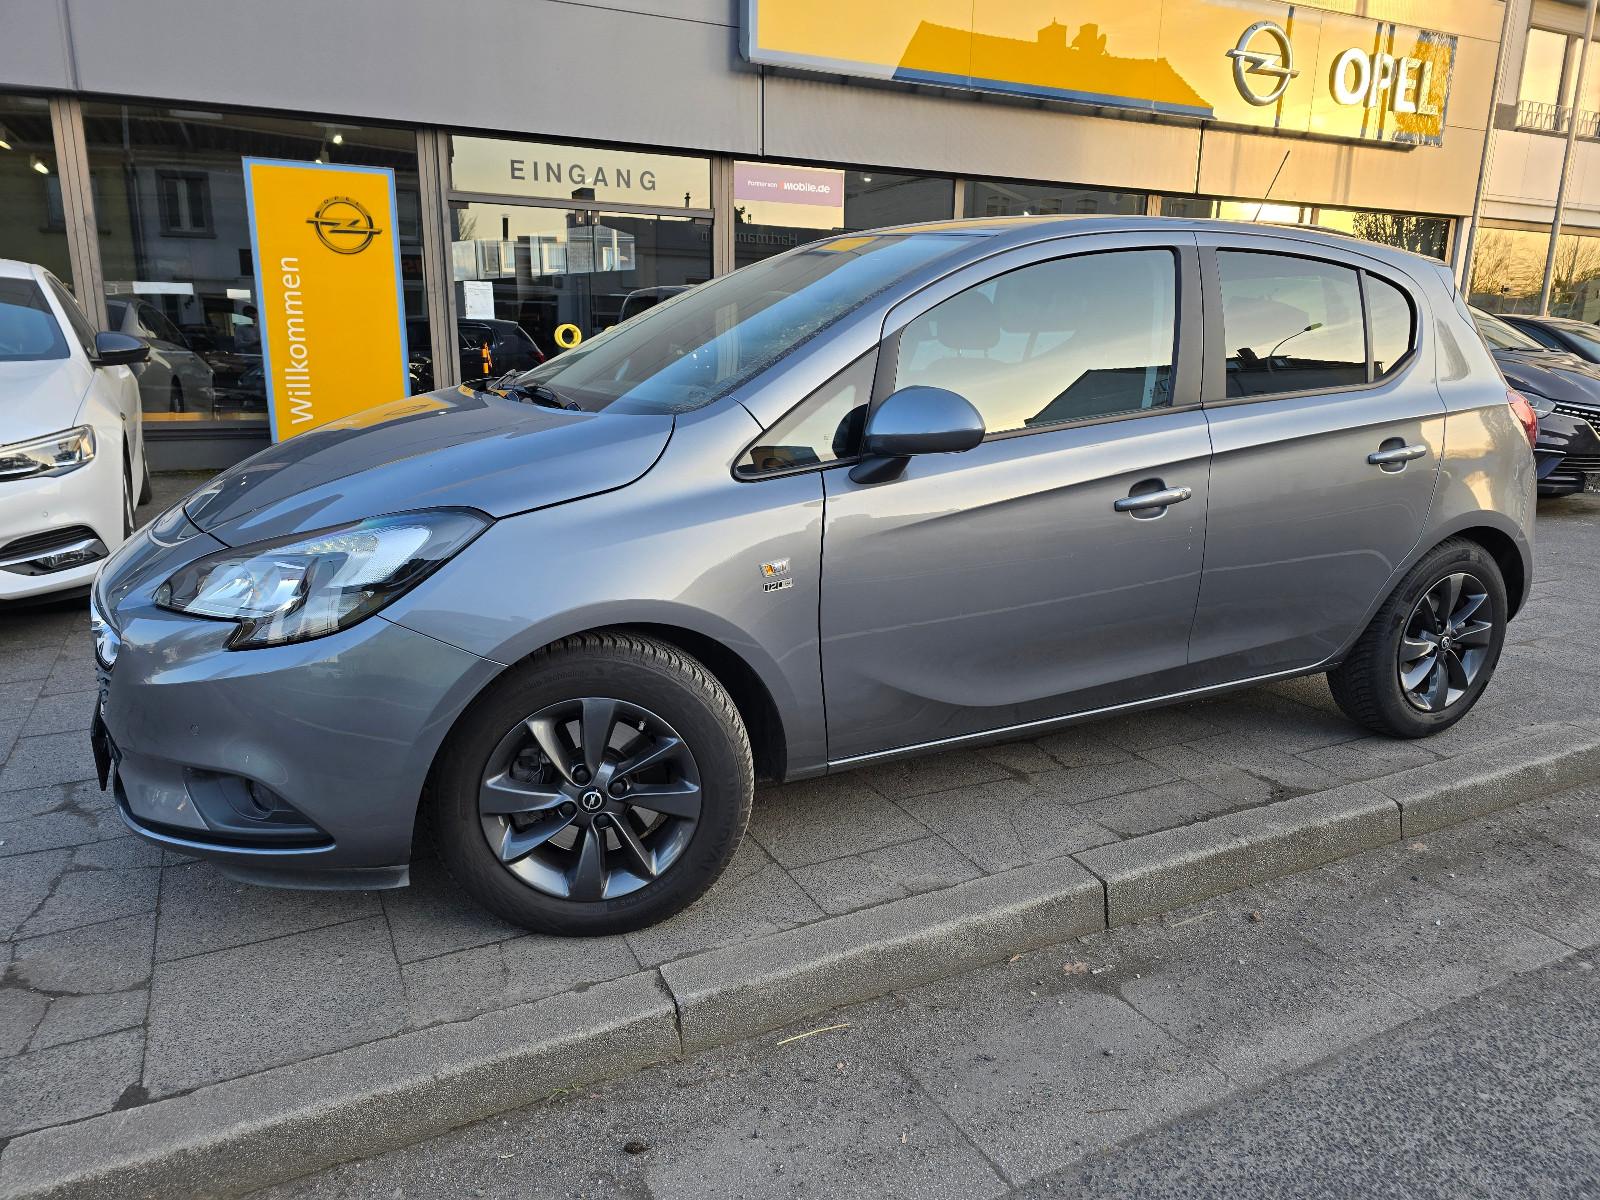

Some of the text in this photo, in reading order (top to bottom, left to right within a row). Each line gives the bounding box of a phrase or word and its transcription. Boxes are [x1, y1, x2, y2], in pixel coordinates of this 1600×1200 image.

[1330, 47, 1439, 115] OPEL
[510, 159, 656, 191] EINGANG
[280, 256, 314, 425] Willkommen
